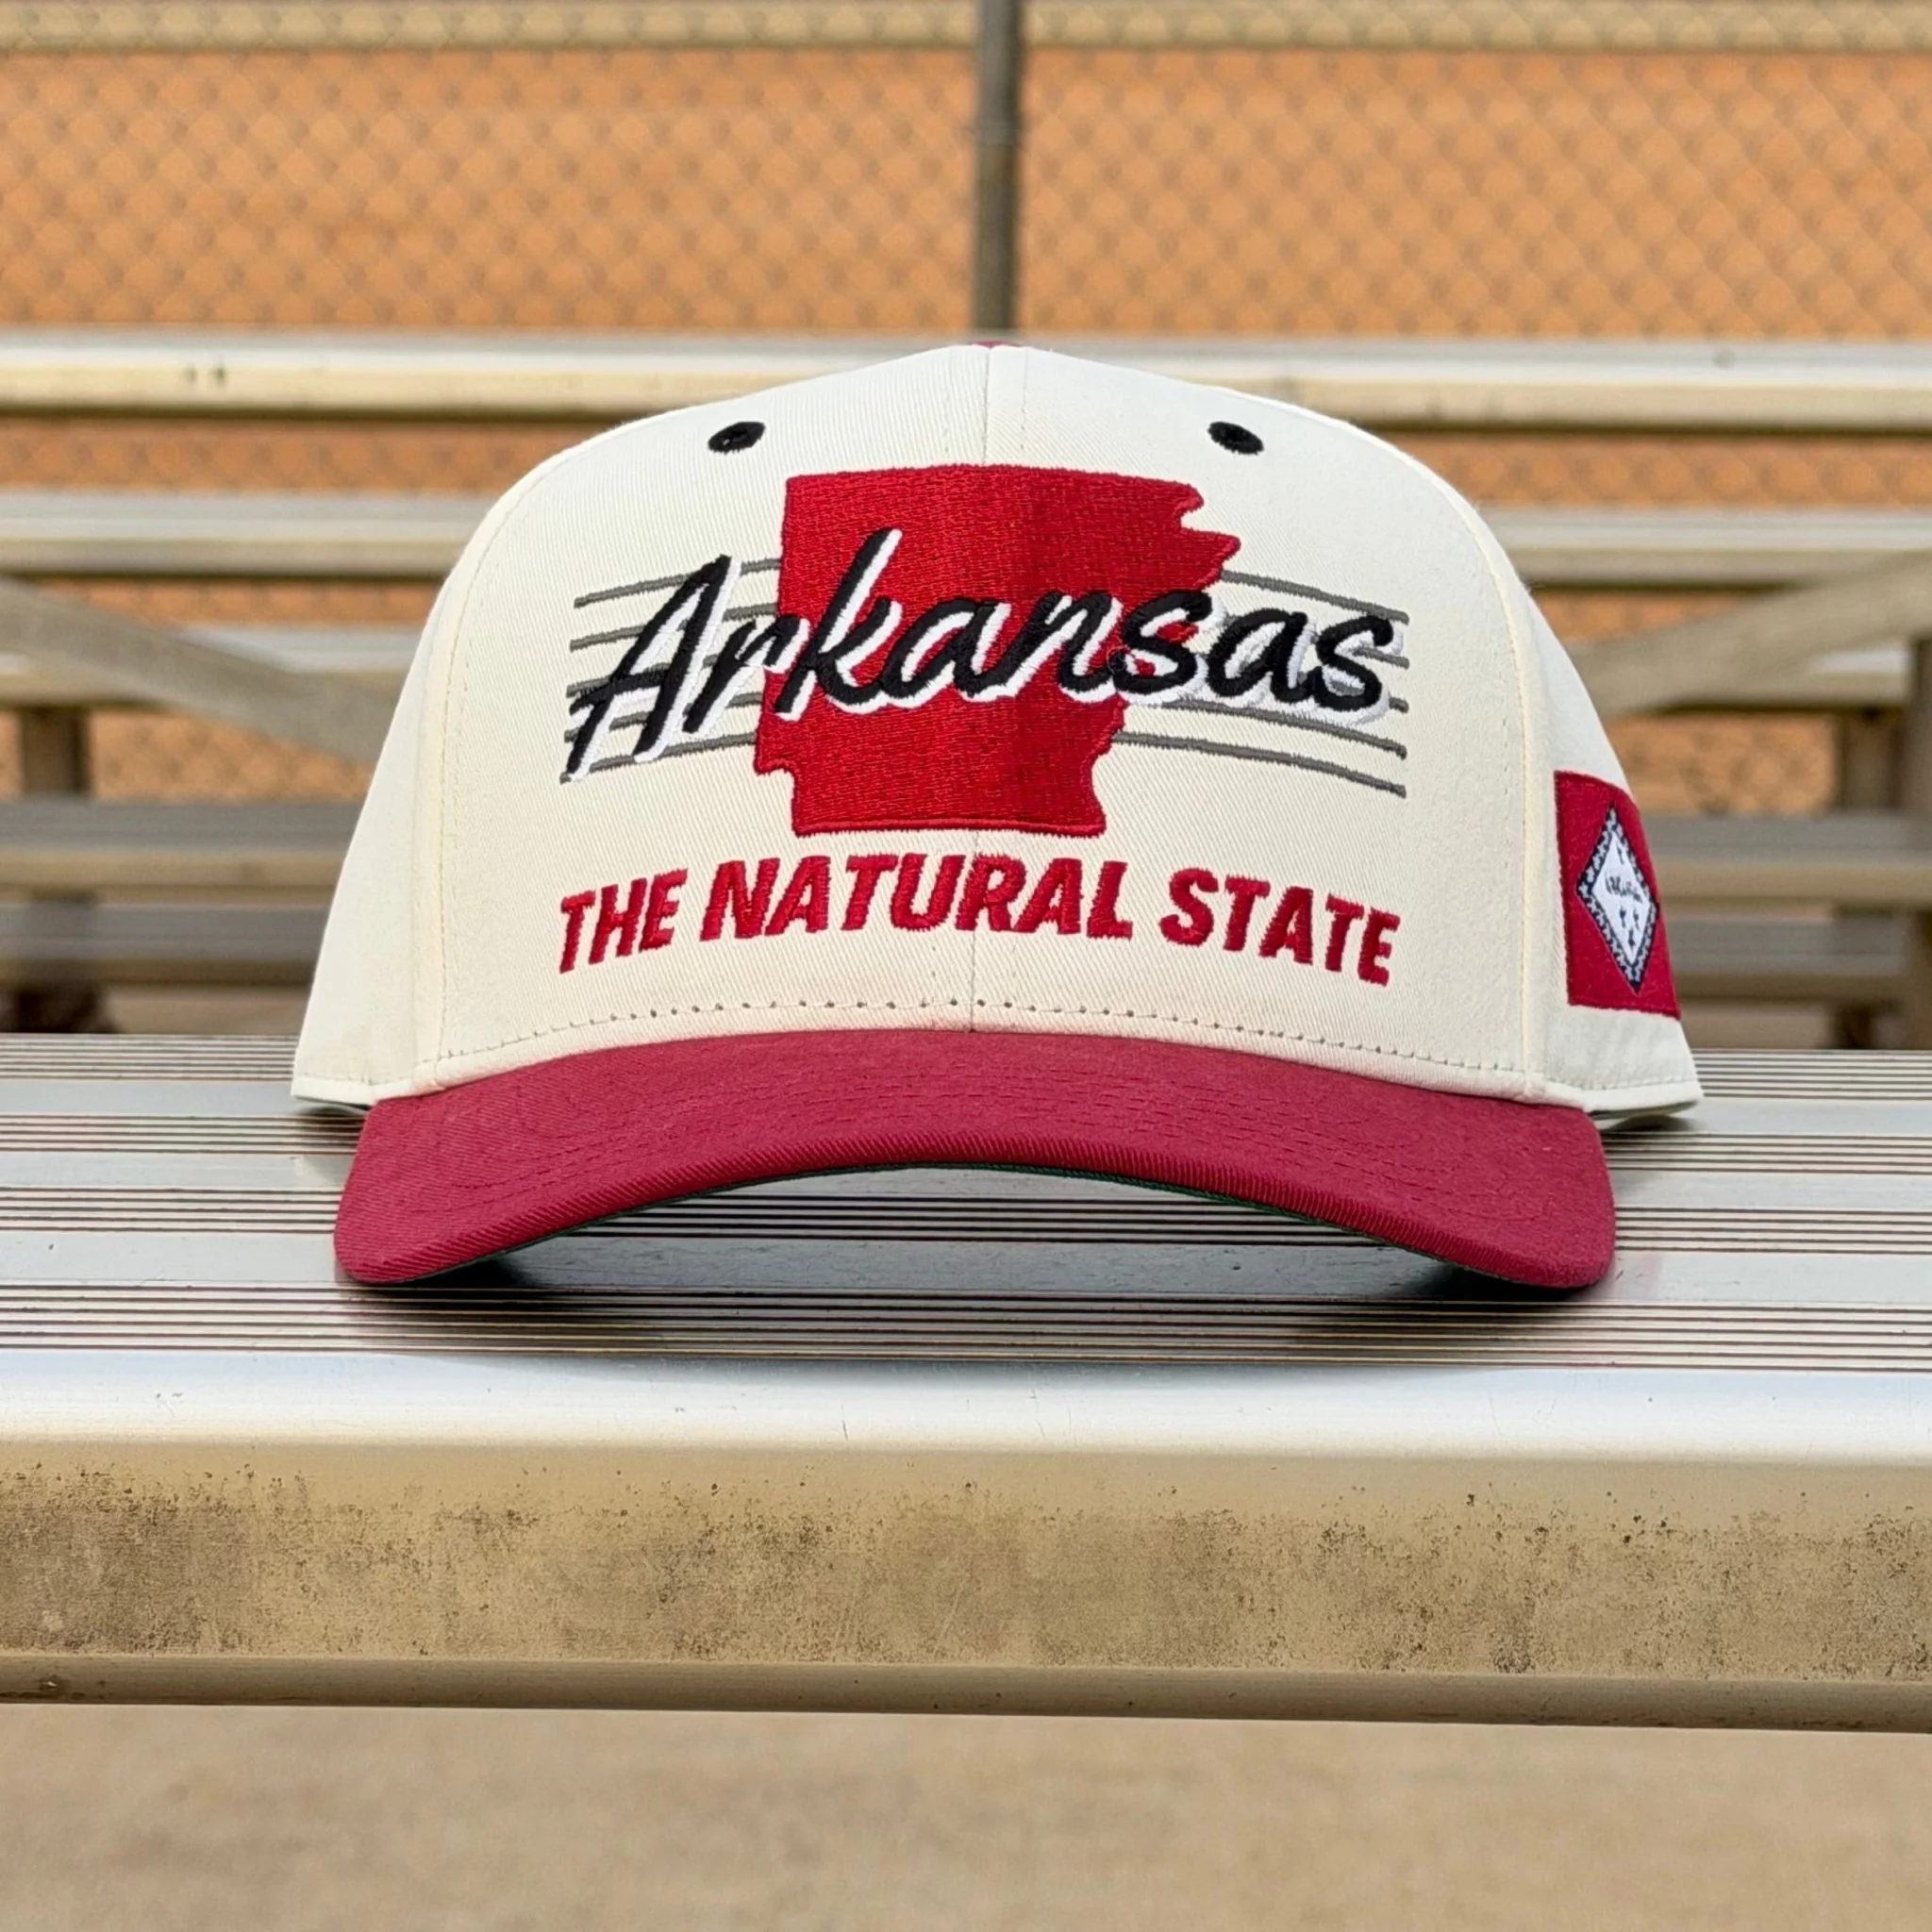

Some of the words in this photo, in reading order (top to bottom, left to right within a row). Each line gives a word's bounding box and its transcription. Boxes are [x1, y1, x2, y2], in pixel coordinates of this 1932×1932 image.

[564, 527, 1405, 782] Arkansas
[559, 869, 688, 974] THE
[699, 853, 1133, 941] NATURAL
[1158, 867, 1401, 986] STATE
